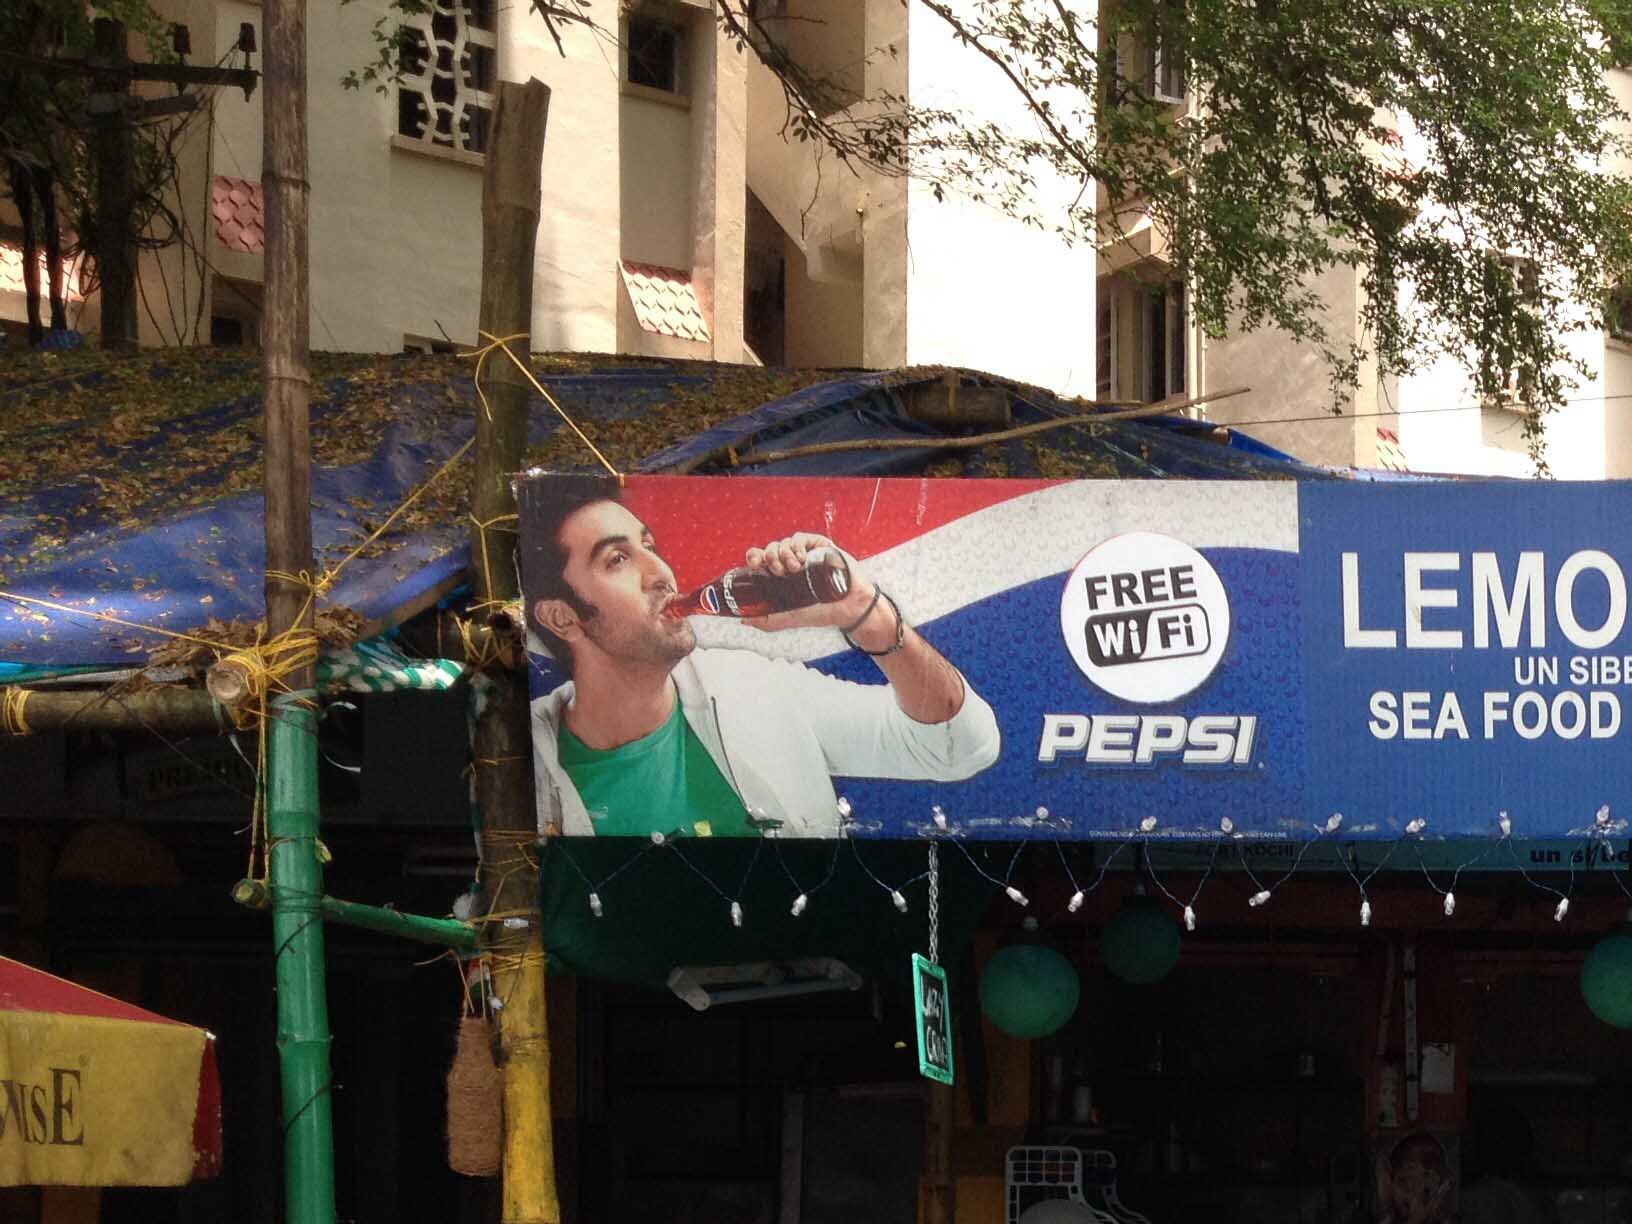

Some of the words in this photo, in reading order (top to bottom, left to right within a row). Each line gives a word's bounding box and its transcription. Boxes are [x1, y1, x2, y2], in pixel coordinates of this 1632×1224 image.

[1083, 564, 1198, 610] FREE
[1514, 655, 1560, 686] UN
[1368, 689, 1470, 741] SEA
[1484, 688, 1622, 740] FOOD
[1037, 713, 1260, 766] PEPSI
[1529, 849, 1561, 864] un
